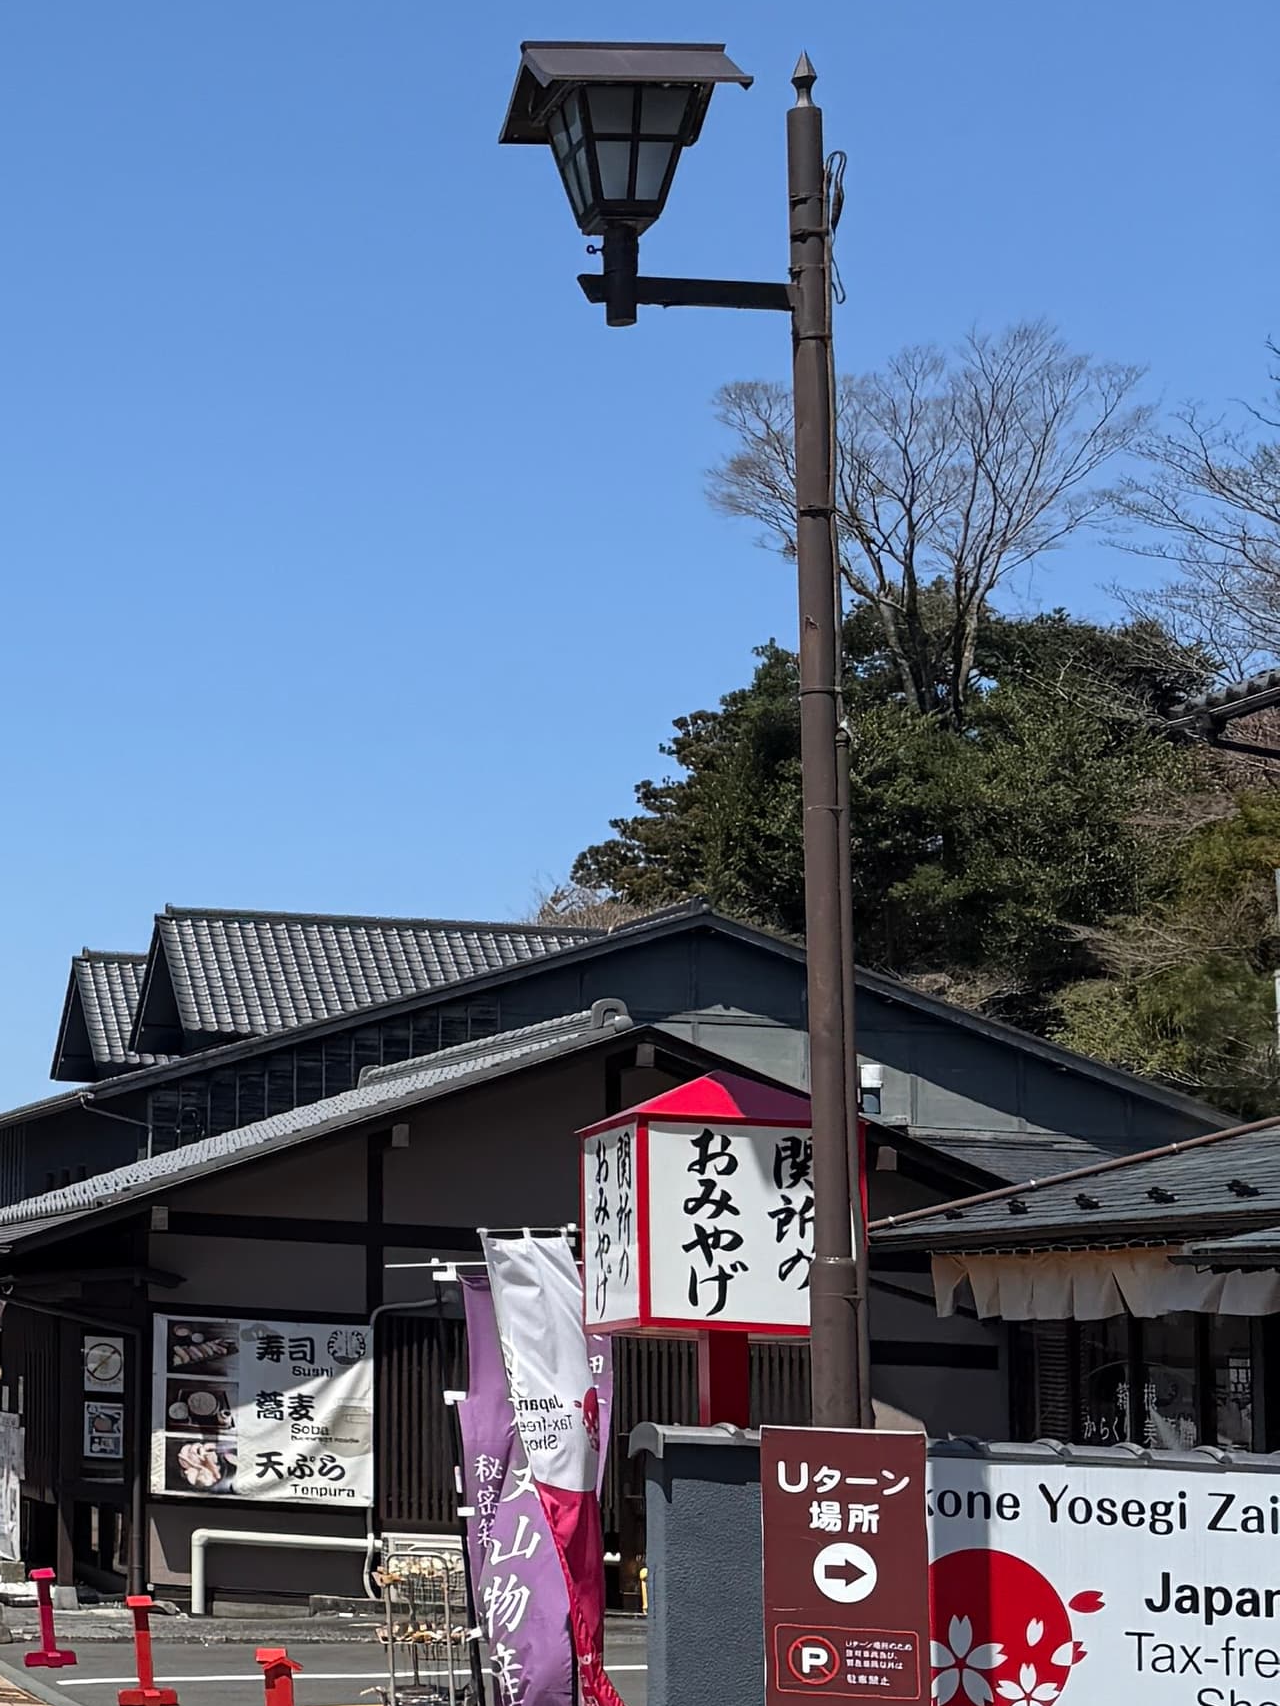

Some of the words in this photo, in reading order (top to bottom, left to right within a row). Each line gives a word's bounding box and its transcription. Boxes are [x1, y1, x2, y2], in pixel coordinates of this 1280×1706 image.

[616, 1131, 633, 1286] 関所の
[681, 1127, 750, 1317] おみやげ
[594, 1139, 612, 1319] おみやげ
[255, 1334, 316, 1365] 寿司
[292, 1365, 334, 1378] Sushi
[255, 1390, 316, 1422] 蕎麦
[291, 1423, 330, 1436] Soba
[255, 1451, 347, 1482] 天ぷら
[776, 1460, 911, 1496] Uターン
[808, 1500, 881, 1534] 場所
[1038, 1482, 1188, 1536] Yosegi
[846, 1673, 891, 1687] 駐車禁止
